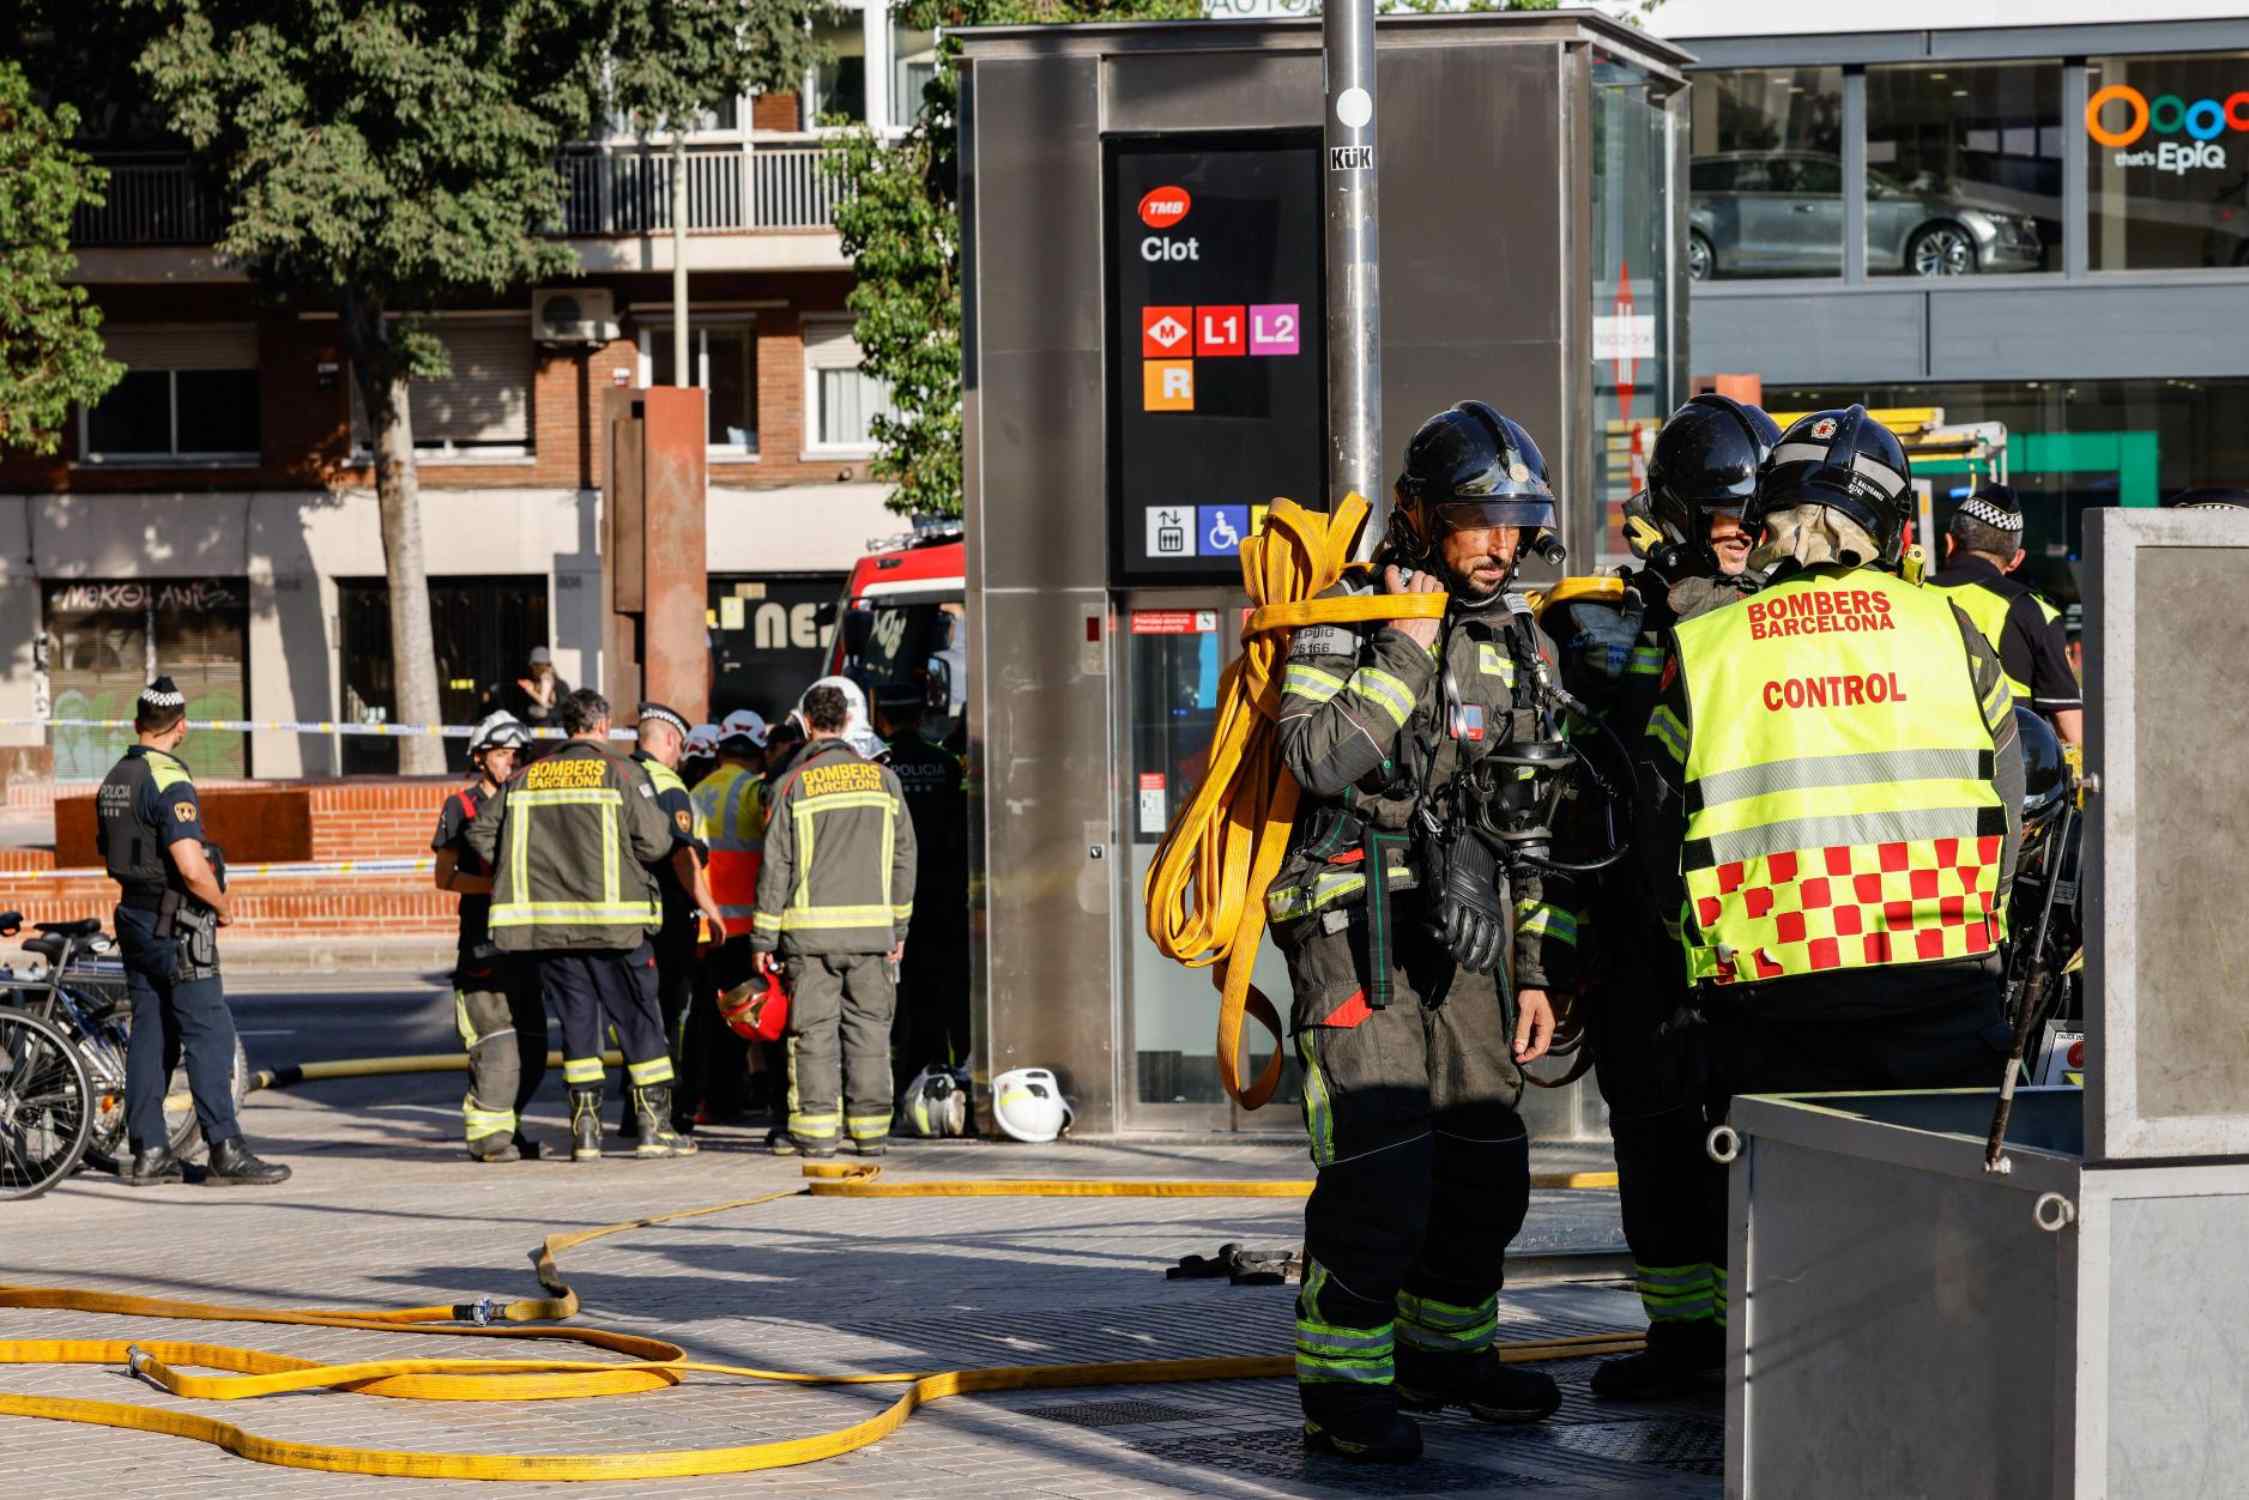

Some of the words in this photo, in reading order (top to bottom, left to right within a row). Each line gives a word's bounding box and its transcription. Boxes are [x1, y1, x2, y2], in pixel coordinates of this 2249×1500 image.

[1149, 201, 1185, 214] TMB
[1140, 236, 1200, 262] Clot
[1160, 325, 1176, 340] M
[1204, 316, 1238, 344] L1
[1254, 315, 1295, 343] L2
[1163, 368, 1192, 398] R
[1747, 590, 1891, 624] BOMBERS
[1750, 613, 1896, 641] BARCELONA
[1763, 672, 1907, 711] CONTROL
[528, 759, 607, 777] BOMBERS
[801, 763, 882, 785] BOMBERS
[527, 776, 602, 790] BARCELONA
[805, 778, 882, 797] BARCELONA
